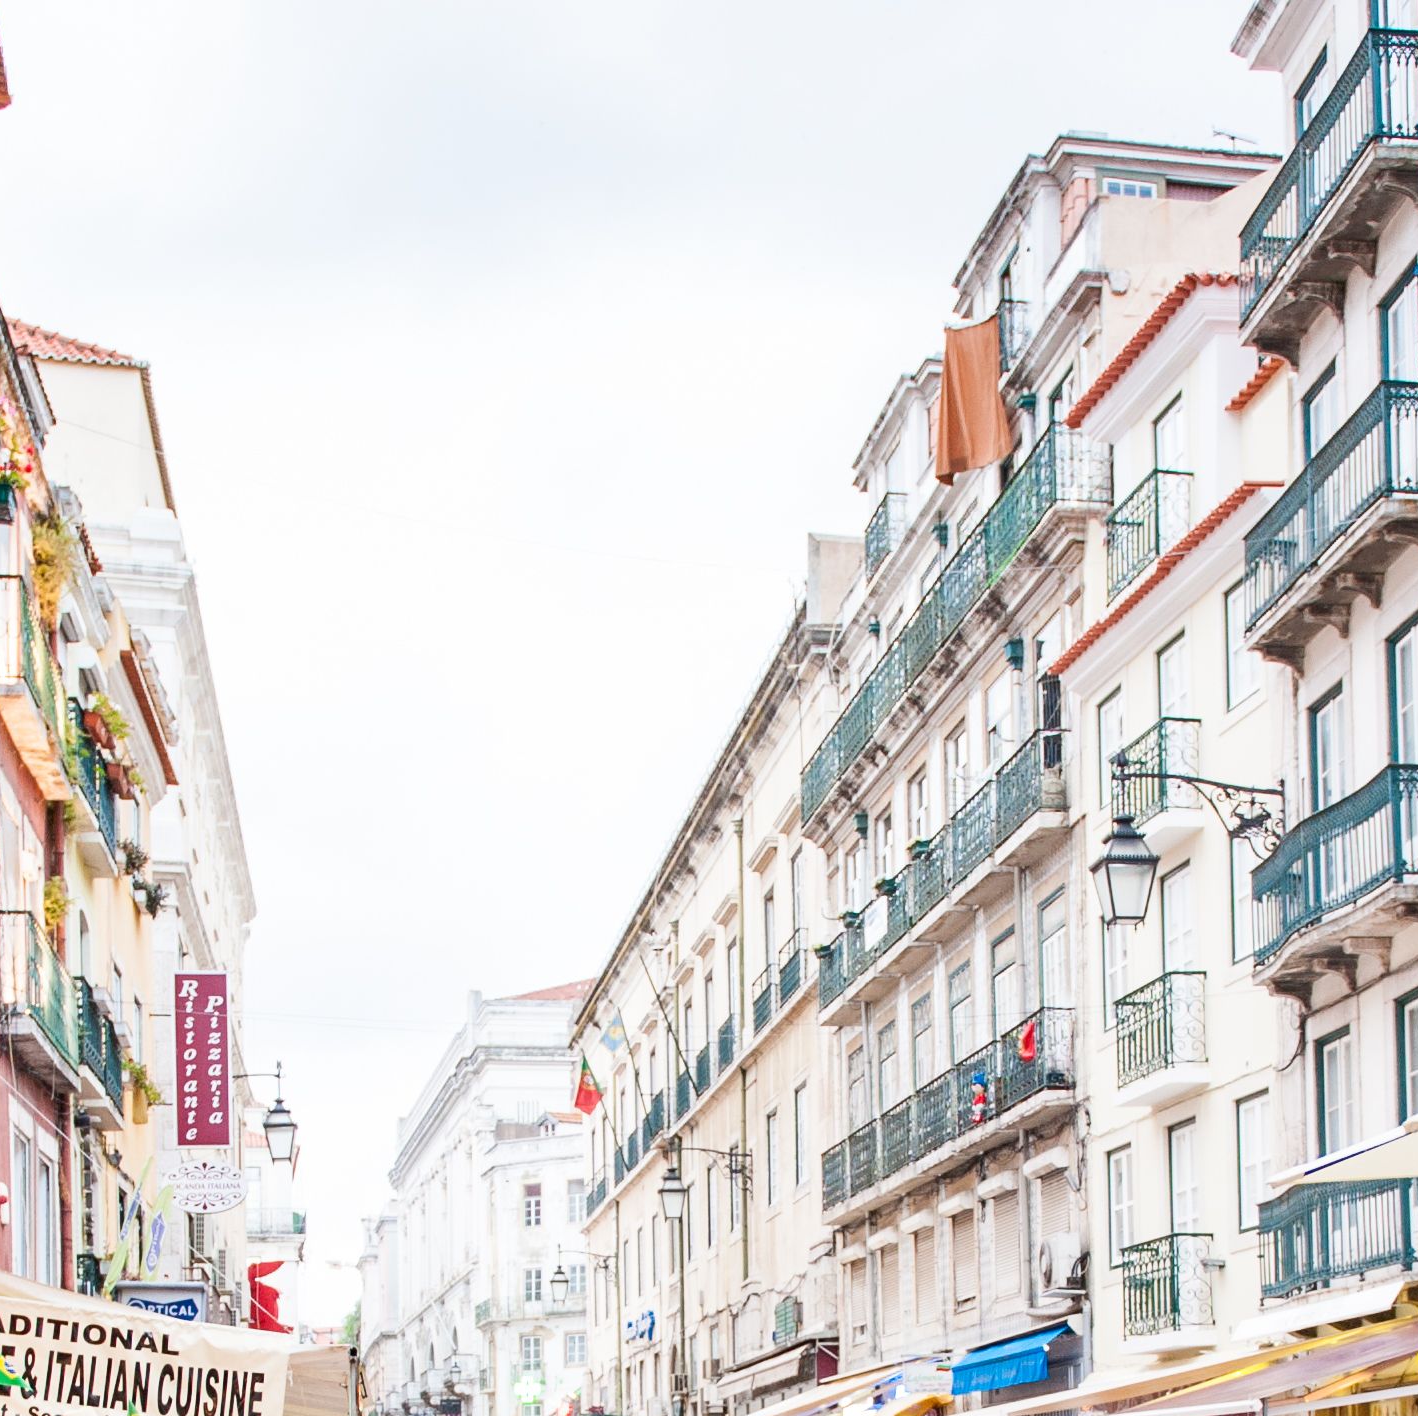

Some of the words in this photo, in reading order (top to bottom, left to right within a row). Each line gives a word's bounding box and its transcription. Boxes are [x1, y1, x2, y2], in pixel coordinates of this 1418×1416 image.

[179, 980, 200, 1141] Ristorante
[204, 995, 224, 1125] Pizzaria
[44, 1350, 150, 1412] ITALIAN
